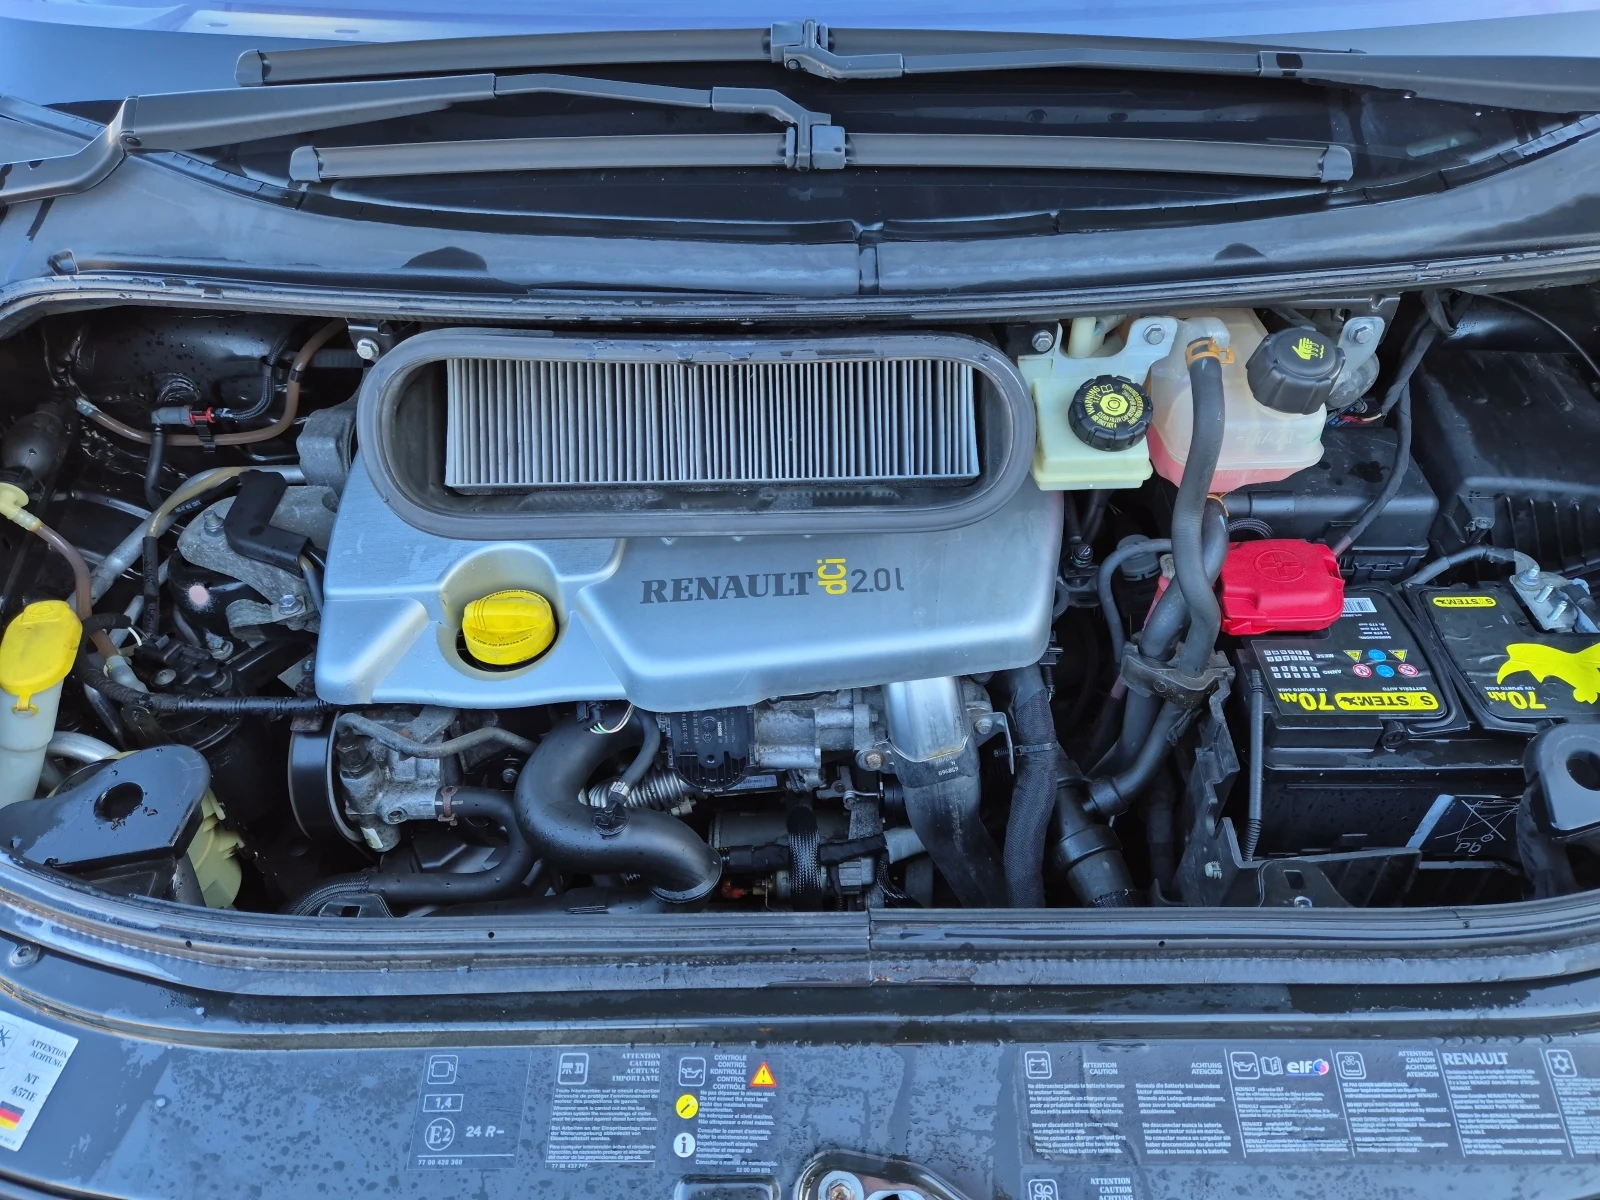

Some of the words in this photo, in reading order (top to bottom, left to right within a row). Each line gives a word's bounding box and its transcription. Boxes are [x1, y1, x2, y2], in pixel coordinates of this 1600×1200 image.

[1085, 386, 1100, 415] WARNING
[640, 571, 814, 604] RENAULT
[817, 558, 847, 595] dCi
[1279, 692, 1335, 710] 70Ah
[1487, 691, 1546, 709] 70Ah
[1454, 842, 1481, 853] Pb
[29, 1039, 68, 1058] ATTENTION
[30, 1050, 63, 1068] ACHTUNG
[1286, 1061, 1313, 1073] elf
[1442, 1052, 1508, 1065] RENAULT
[24, 1073, 39, 1085] NT
[11, 1085, 38, 1102] 4571E
[435, 1097, 452, 1109] 1,4
[428, 1126, 451, 1144] E2
[466, 1126, 481, 1137] 24
